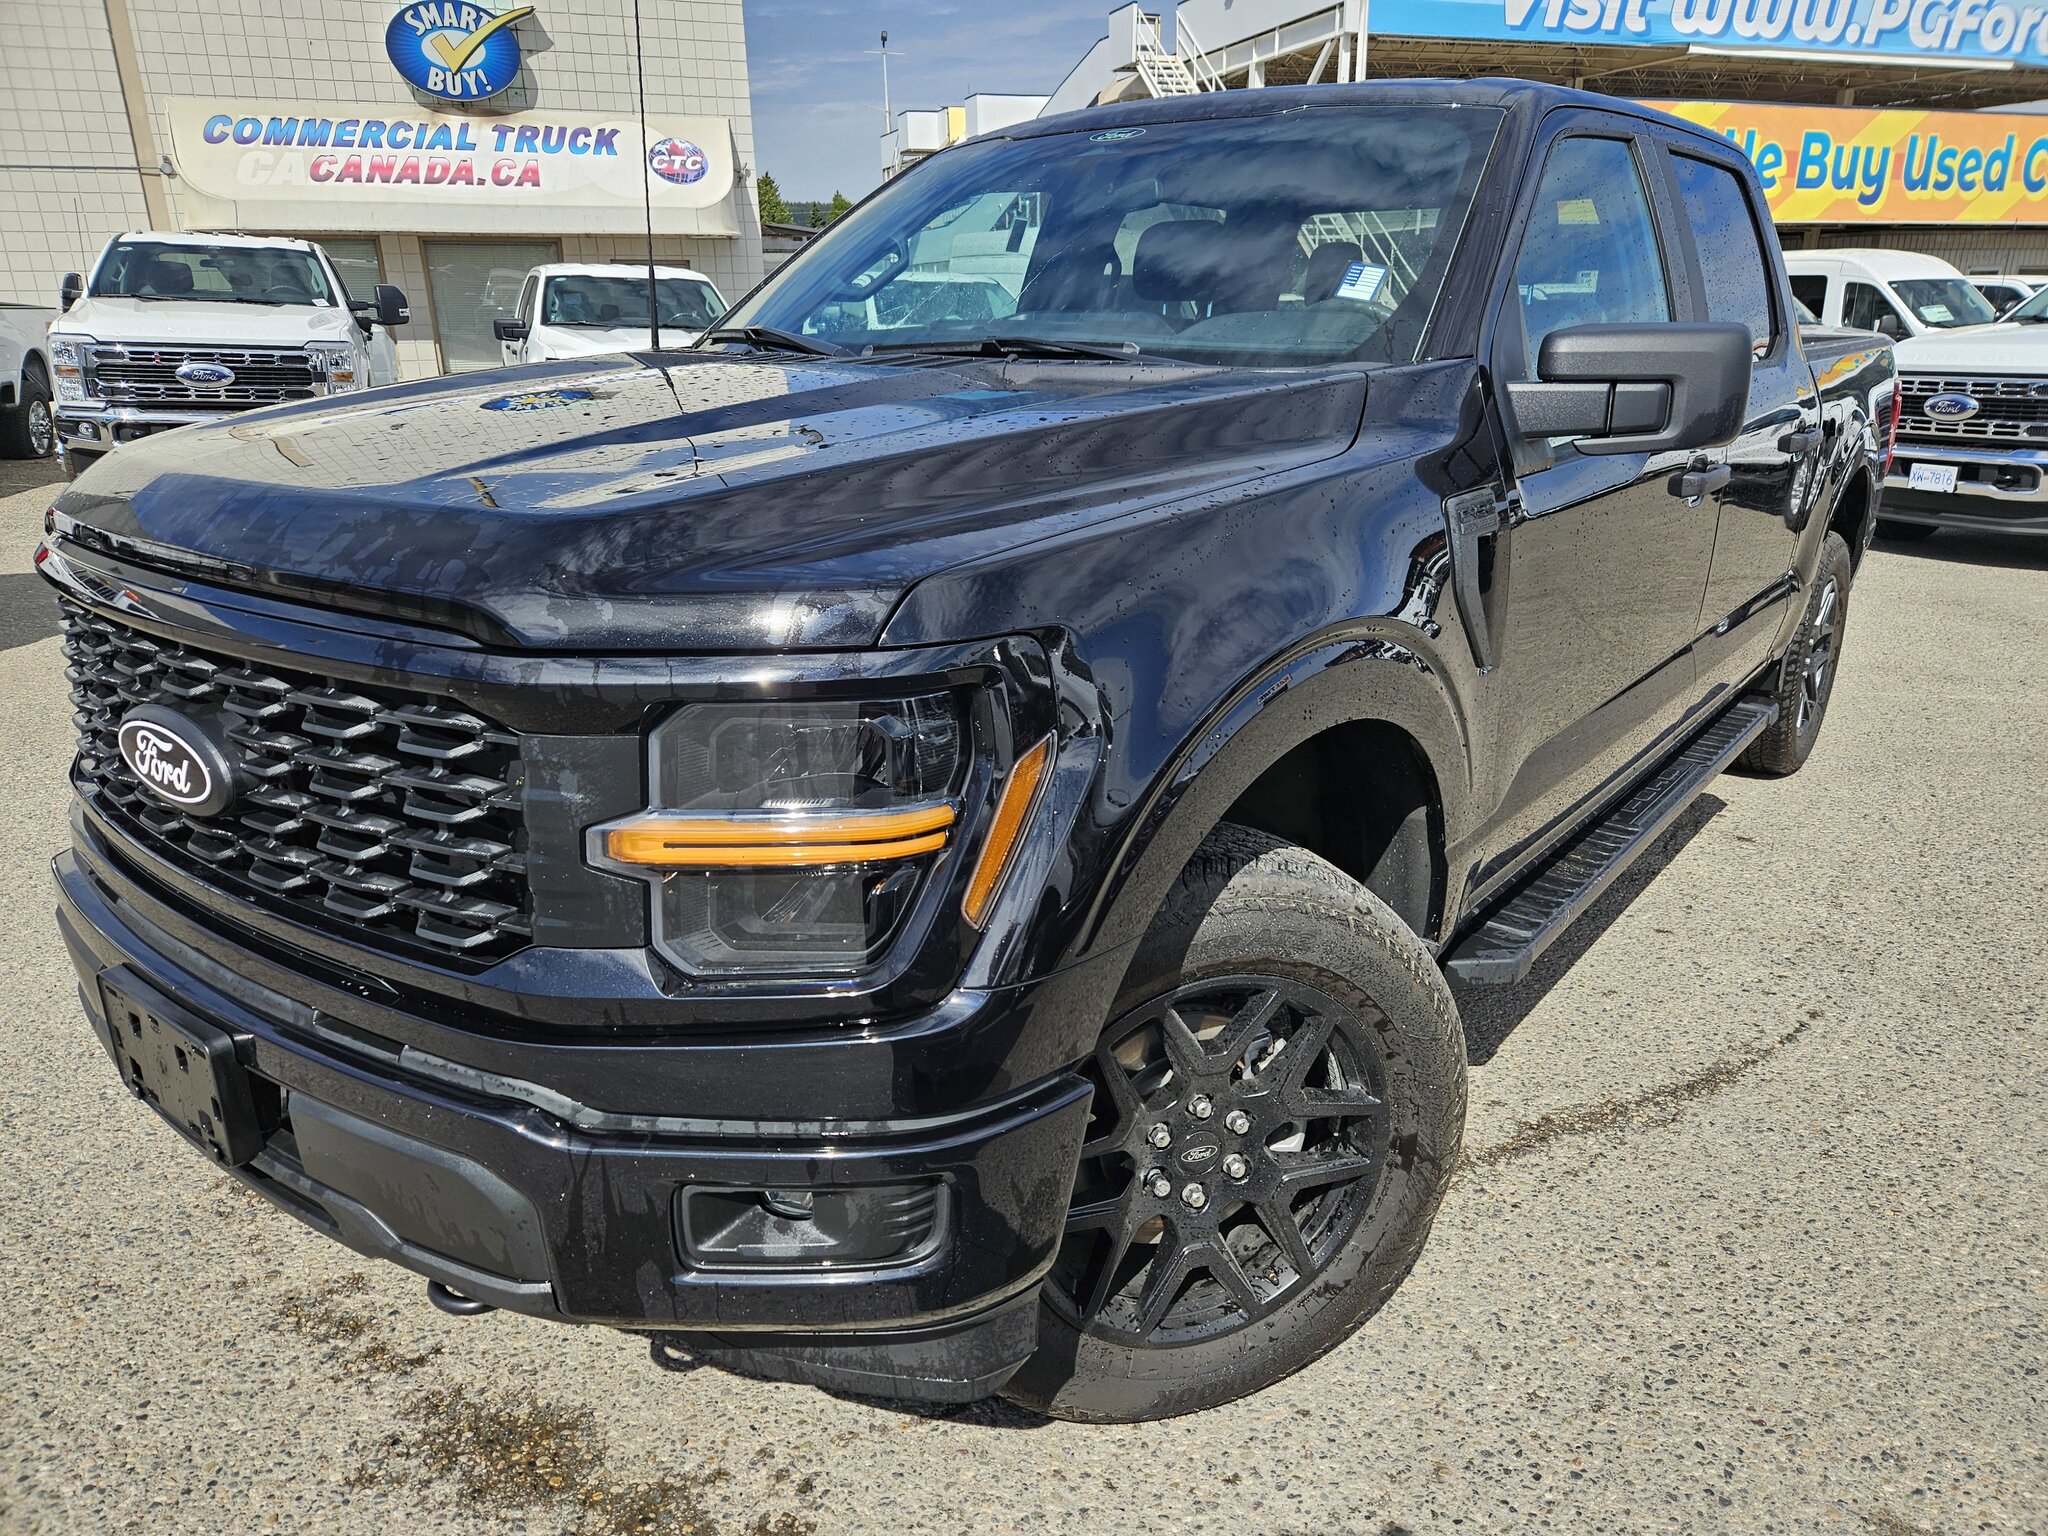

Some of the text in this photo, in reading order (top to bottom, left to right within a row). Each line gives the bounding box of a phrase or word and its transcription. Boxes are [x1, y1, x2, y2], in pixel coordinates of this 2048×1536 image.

[404, 2, 494, 36] SMART
[1670, 0, 2048, 56] www.PGFor
[427, 66, 492, 96] BUY!
[203, 115, 620, 155] COMMERCIAL TRUCK
[309, 154, 541, 187] CANADA.CA
[652, 155, 702, 170] CTC
[1725, 128, 1783, 189] e
[1796, 131, 1891, 205] Buy
[1904, 134, 2015, 192] Used
[1935, 400, 1961, 413] Ford
[135, 729, 191, 794] Ford
[1187, 1147, 1212, 1160] Ford
